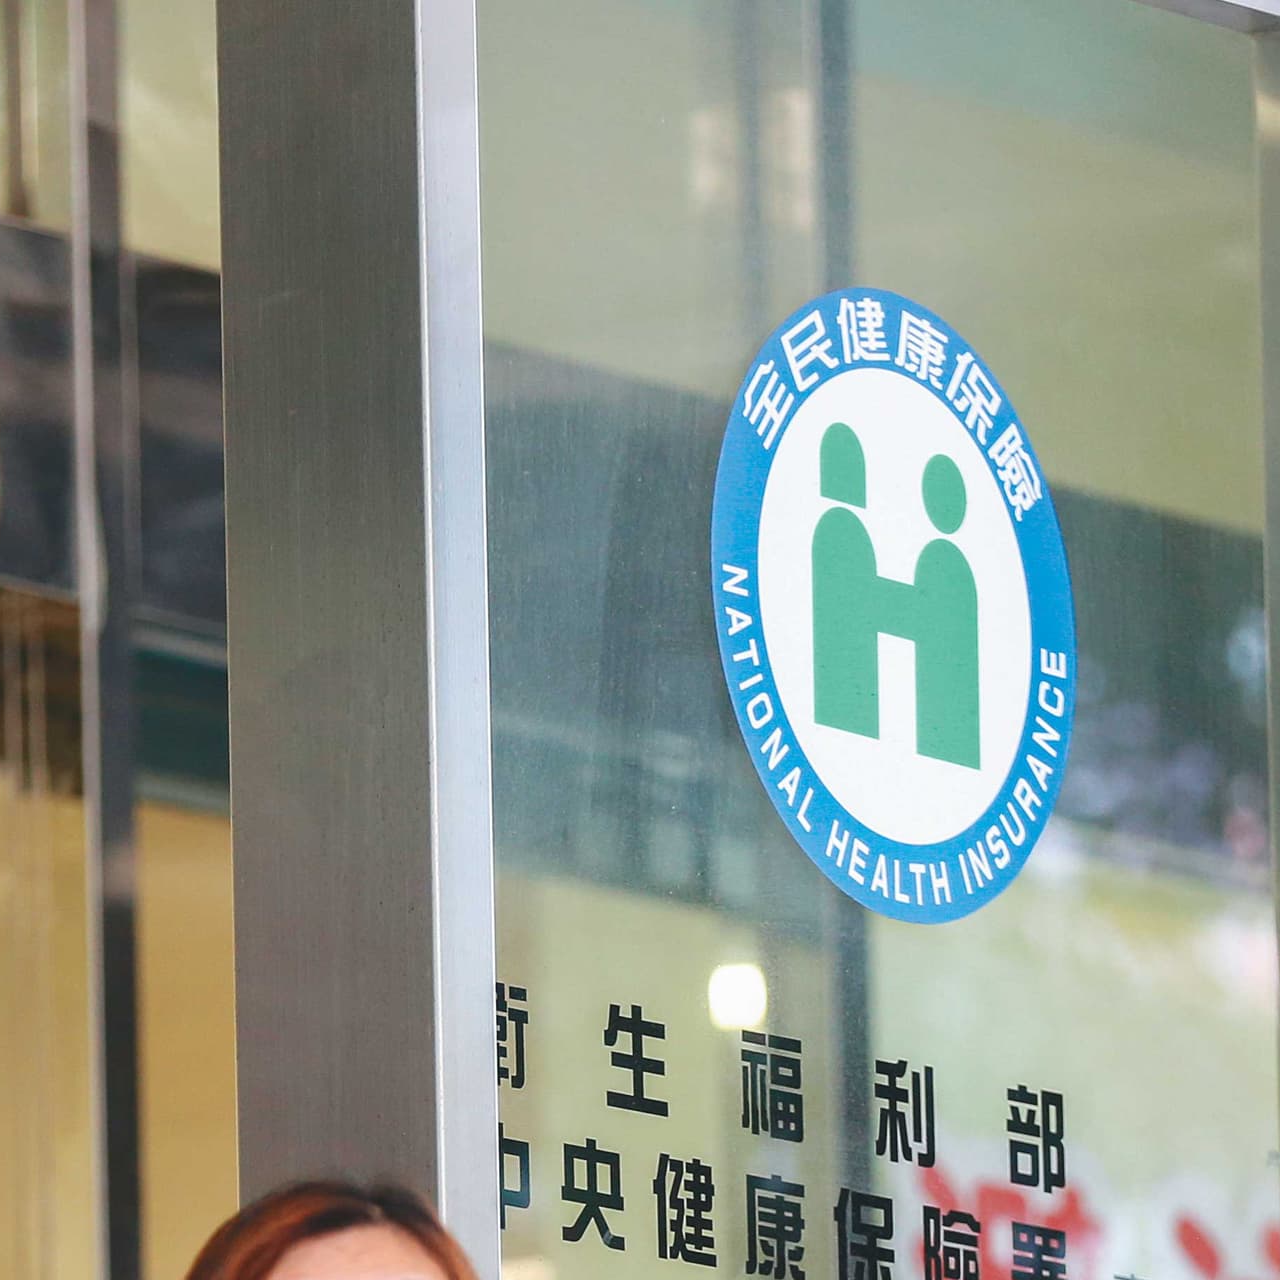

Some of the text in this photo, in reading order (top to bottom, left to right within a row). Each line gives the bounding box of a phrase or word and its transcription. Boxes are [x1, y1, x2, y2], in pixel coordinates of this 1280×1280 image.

[742, 297, 1042, 522] 全民健康保險
[722, 563, 1066, 904] NATIONAL HEALTH INSURANCE
